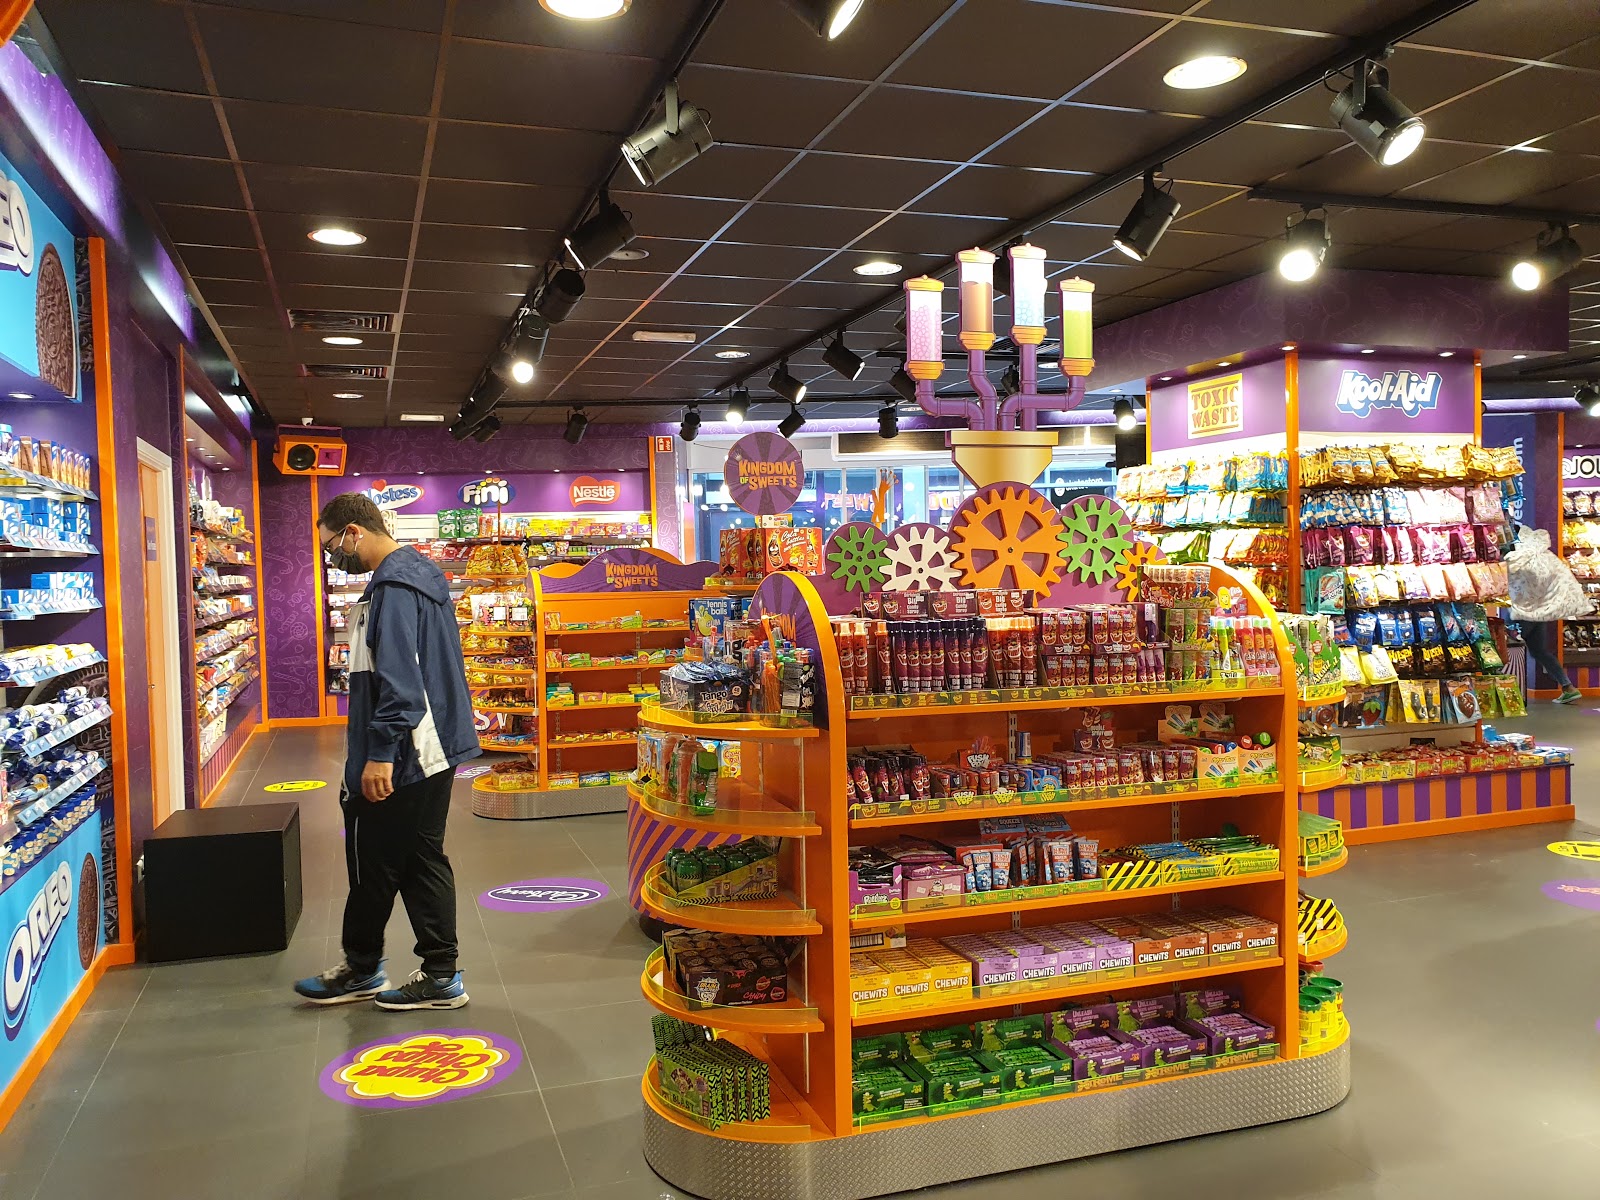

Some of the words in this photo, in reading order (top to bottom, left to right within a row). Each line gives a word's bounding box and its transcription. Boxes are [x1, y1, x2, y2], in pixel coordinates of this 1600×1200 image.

[1191, 386, 1239, 410] TOXIC
[1337, 371, 1438, 413] Kool-Aid
[1191, 405, 1239, 428] WASTE
[738, 459, 797, 477] KINGDOM
[463, 479, 508, 505] Fini
[739, 476, 749, 485] OF
[749, 475, 798, 491] SWEETS
[605, 562, 658, 577] KINGDOM
[614, 576, 659, 589] SWEETS
[707, 600, 728, 608] tennis
[700, 691, 728, 701] Tango
[953, 791, 974, 799] PUSH
[4, 861, 72, 1015] OREO
[374, 1049, 491, 1069] Chups
[352, 1063, 470, 1084] Chupa
